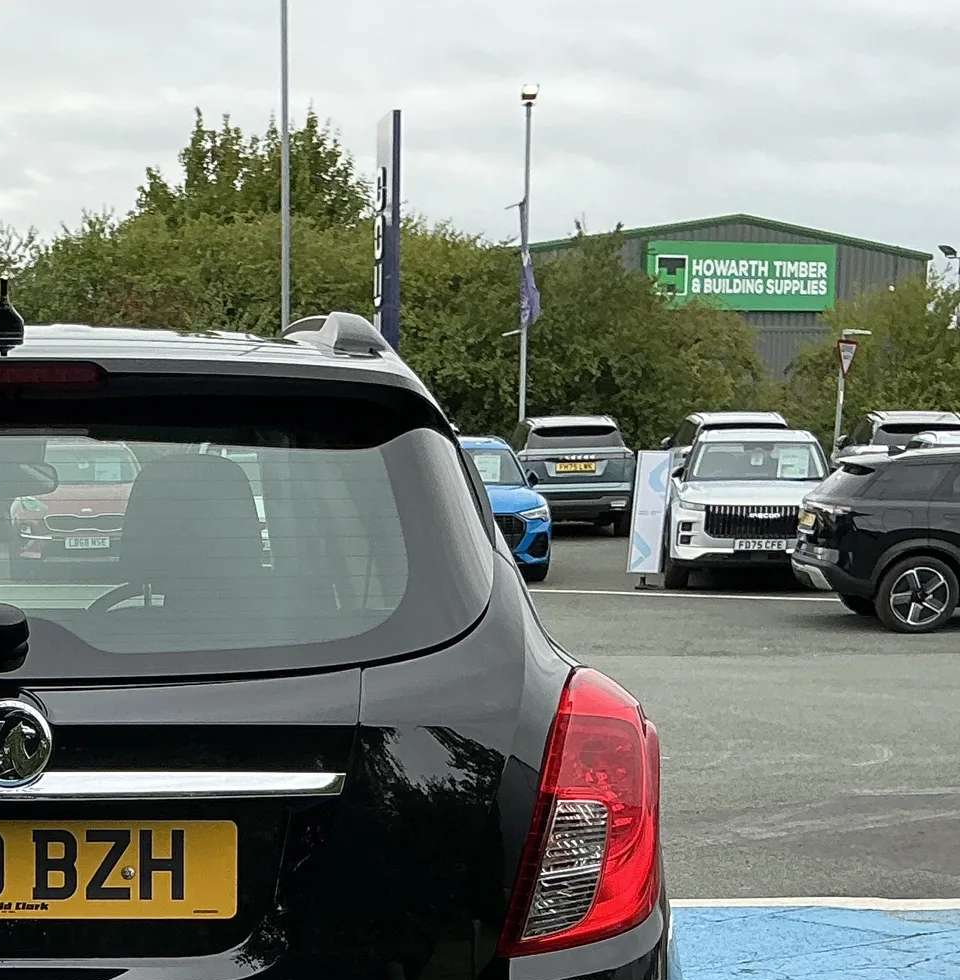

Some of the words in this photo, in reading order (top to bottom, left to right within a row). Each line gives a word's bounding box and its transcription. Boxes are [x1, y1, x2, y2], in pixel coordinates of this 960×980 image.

[692, 259, 768, 277] HOWARTH
[774, 261, 828, 278] TIMBER
[692, 279, 701, 293] &
[703, 279, 763, 294] BUILDING
[766, 280, 828, 295] SUPPLIES
[739, 540, 763, 549] FD75
[765, 540, 784, 549] CFE
[32, 829, 185, 900] BZH
[15, 902, 48, 910] Clark
